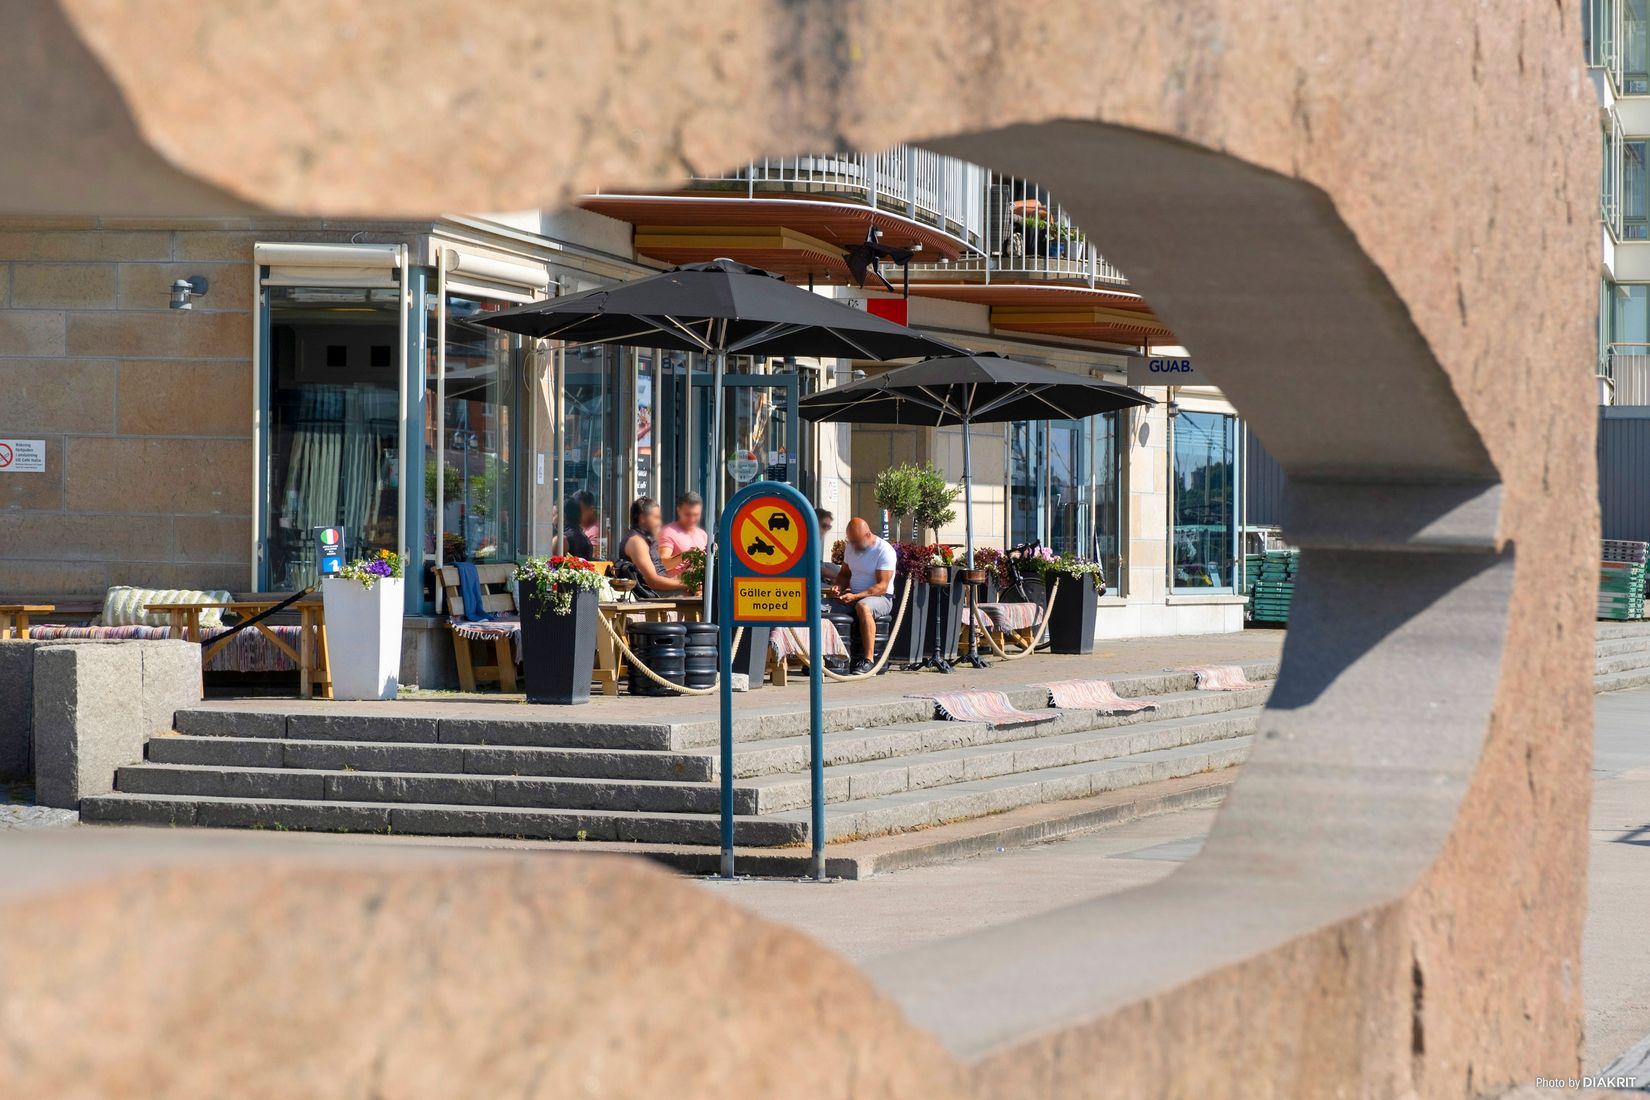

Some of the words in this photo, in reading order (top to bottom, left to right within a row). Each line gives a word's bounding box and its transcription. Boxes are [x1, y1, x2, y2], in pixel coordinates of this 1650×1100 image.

[740, 588, 772, 597] Gäller
[775, 588, 801, 597] även
[752, 601, 788, 612] moped
